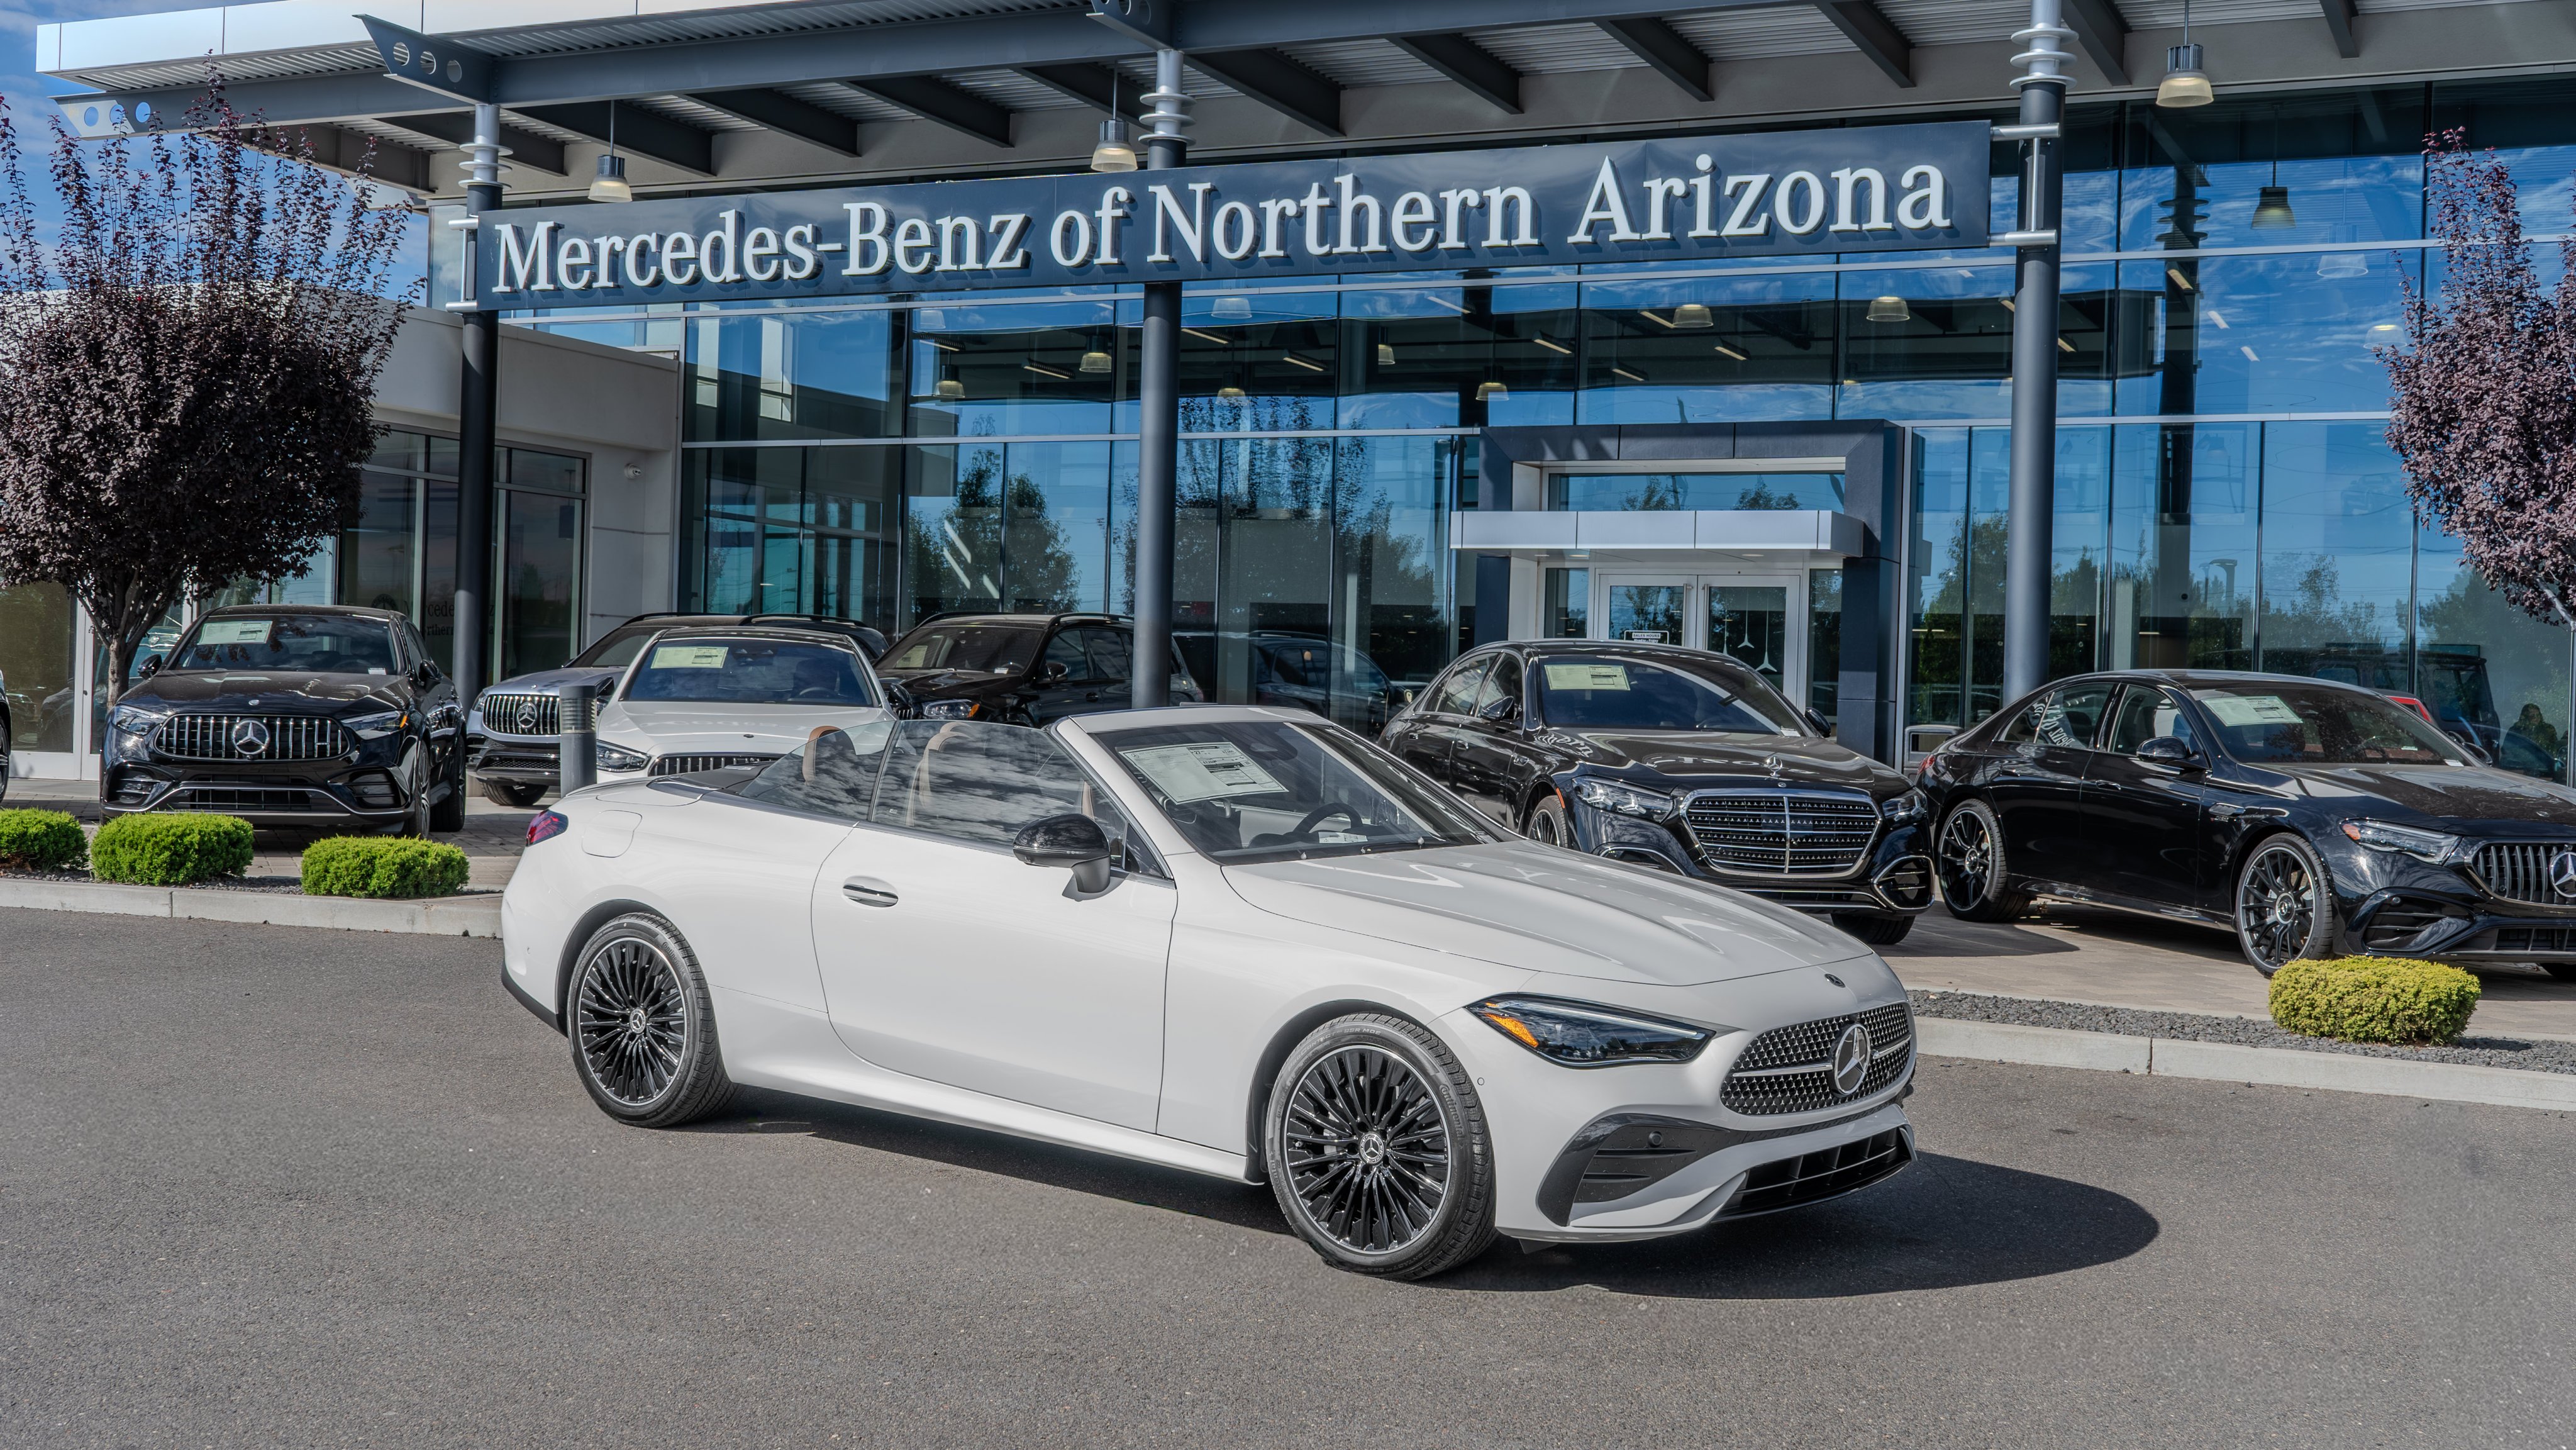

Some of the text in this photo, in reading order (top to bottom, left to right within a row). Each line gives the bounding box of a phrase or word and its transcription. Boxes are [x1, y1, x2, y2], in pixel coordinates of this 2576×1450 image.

[492, 153, 1951, 292] Mercedes-Benz of Northern Arizona
[1439, 1083, 1464, 1141] Continental
